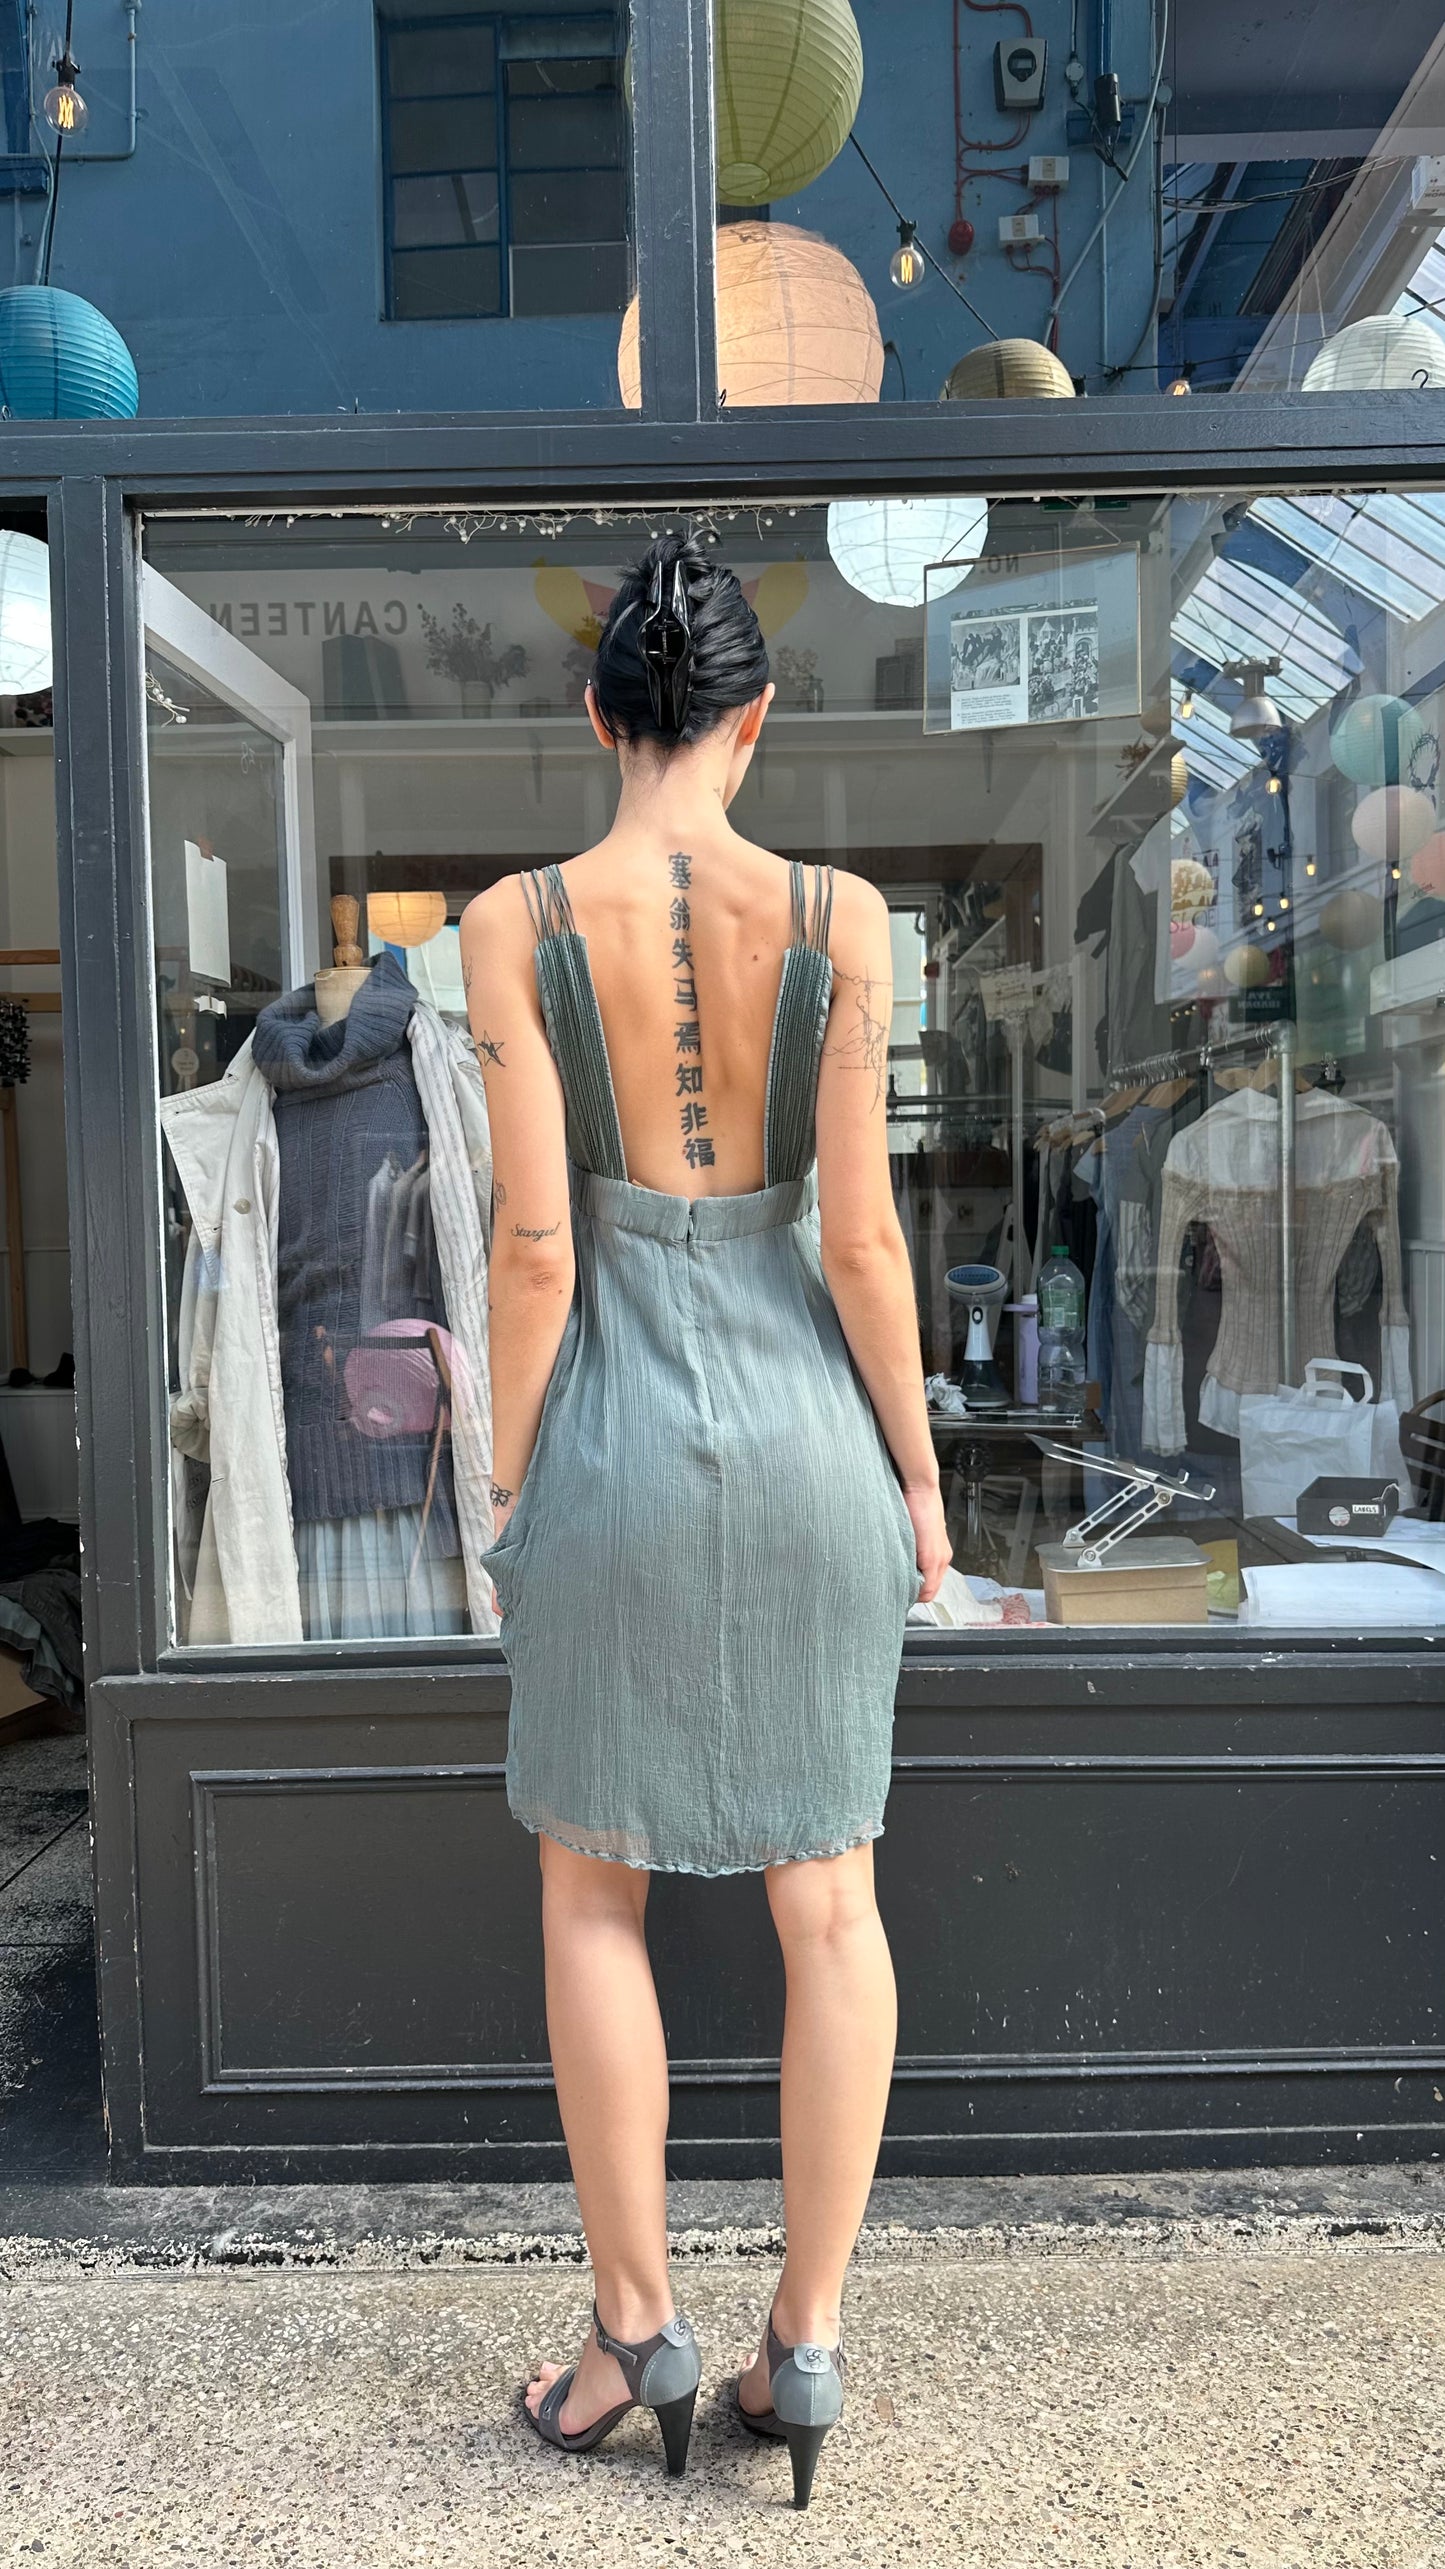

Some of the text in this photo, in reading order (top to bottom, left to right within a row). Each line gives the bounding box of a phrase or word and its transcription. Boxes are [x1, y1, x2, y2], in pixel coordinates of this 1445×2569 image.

[668, 851, 716, 1170] 塞翁失马焉知非福
[1353, 1505, 1377, 1513] LABELS
